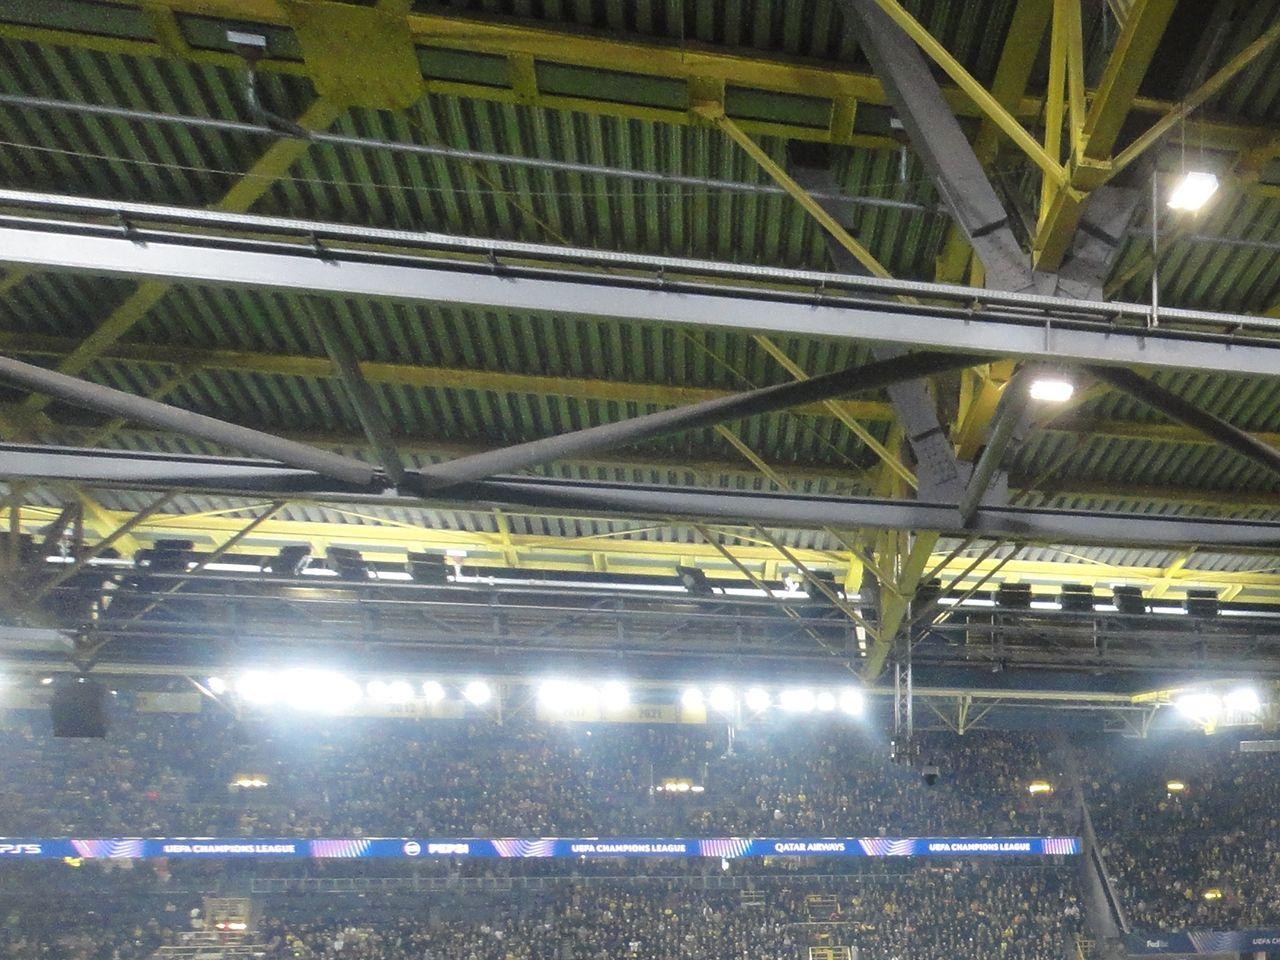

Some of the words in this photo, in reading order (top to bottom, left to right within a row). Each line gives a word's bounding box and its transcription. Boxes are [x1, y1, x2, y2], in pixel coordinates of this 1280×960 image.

[163, 845, 191, 853] UEFA
[192, 845, 254, 853] CHAMPIONS
[255, 844, 296, 853] LEAGUE
[428, 843, 469, 855] PEPSI
[571, 844, 595, 853] UEFA
[596, 844, 650, 853] CHAMPIONS
[651, 844, 686, 852] LEAGUE
[775, 843, 808, 854] QATAR
[809, 843, 845, 852] AIRWAYS
[929, 843, 950, 852] UEFA
[951, 843, 1000, 852] CHAMPIONS
[1000, 843, 1030, 851] LEAGUE
